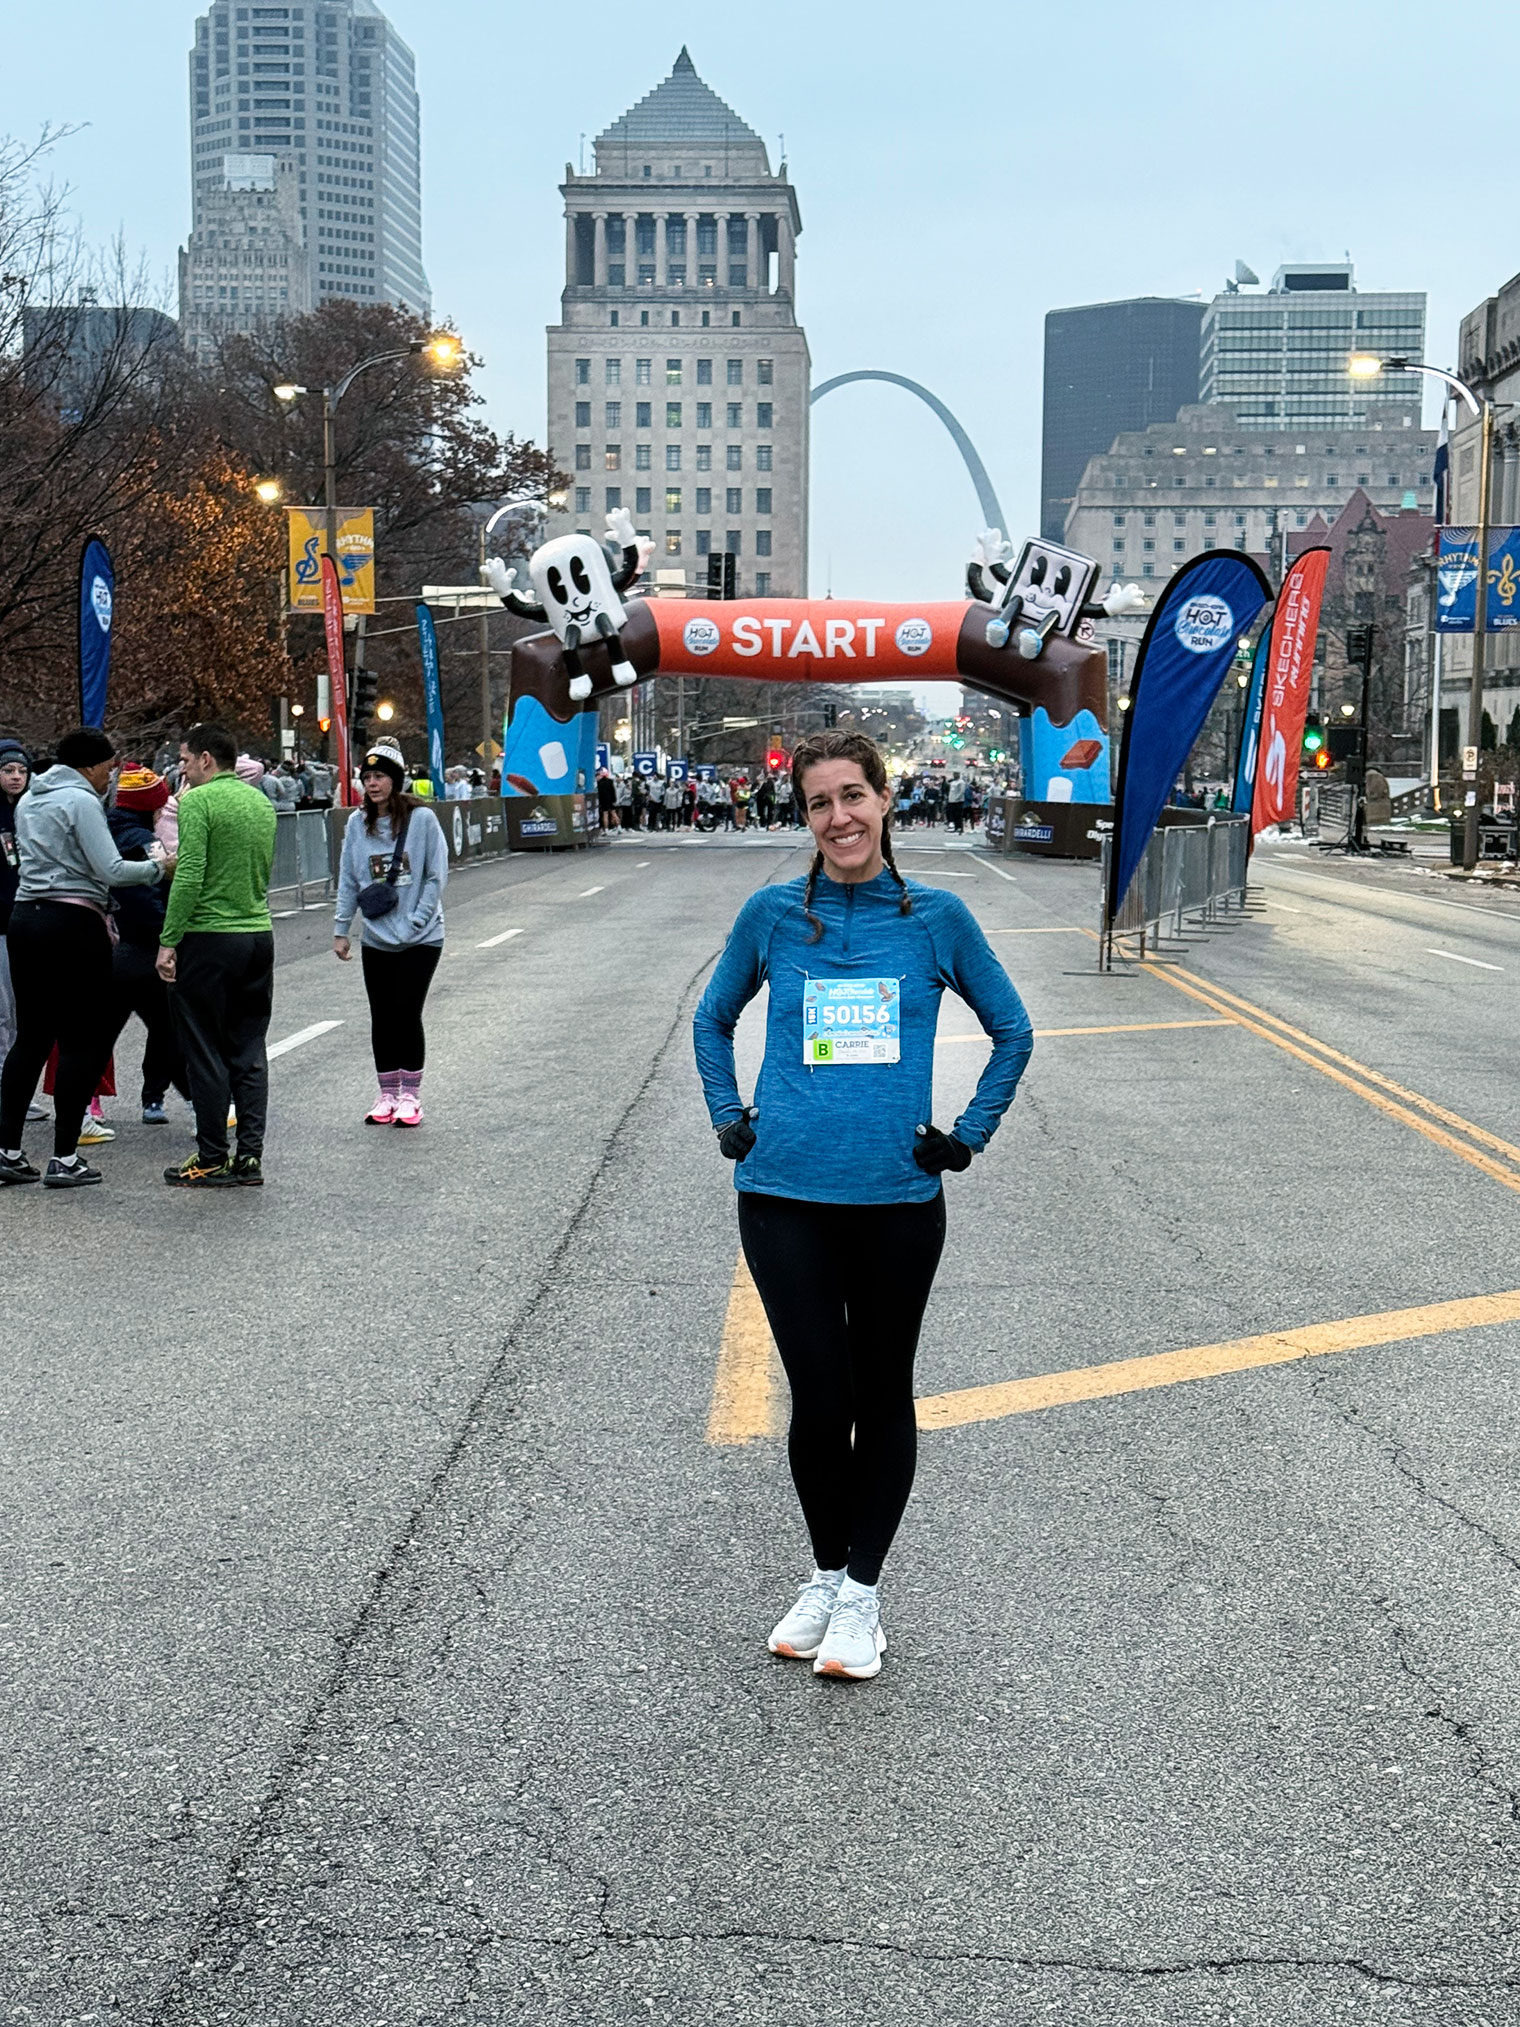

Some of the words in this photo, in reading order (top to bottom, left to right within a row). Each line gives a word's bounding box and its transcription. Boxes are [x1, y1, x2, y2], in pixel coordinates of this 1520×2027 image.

[1186, 608, 1227, 626] HOT
[689, 627, 715, 638] HOT
[731, 616, 886, 658] START
[902, 627, 927, 639] HOT
[1191, 636, 1213, 646] RUN
[1272, 573, 1304, 707] SKECHERS
[638, 759, 653, 775] C
[671, 766, 683, 779] D
[808, 1008, 816, 1024] 15K
[823, 1005, 890, 1024] 50156
[818, 1044, 829, 1056] B
[835, 1041, 869, 1049] CARRIE
